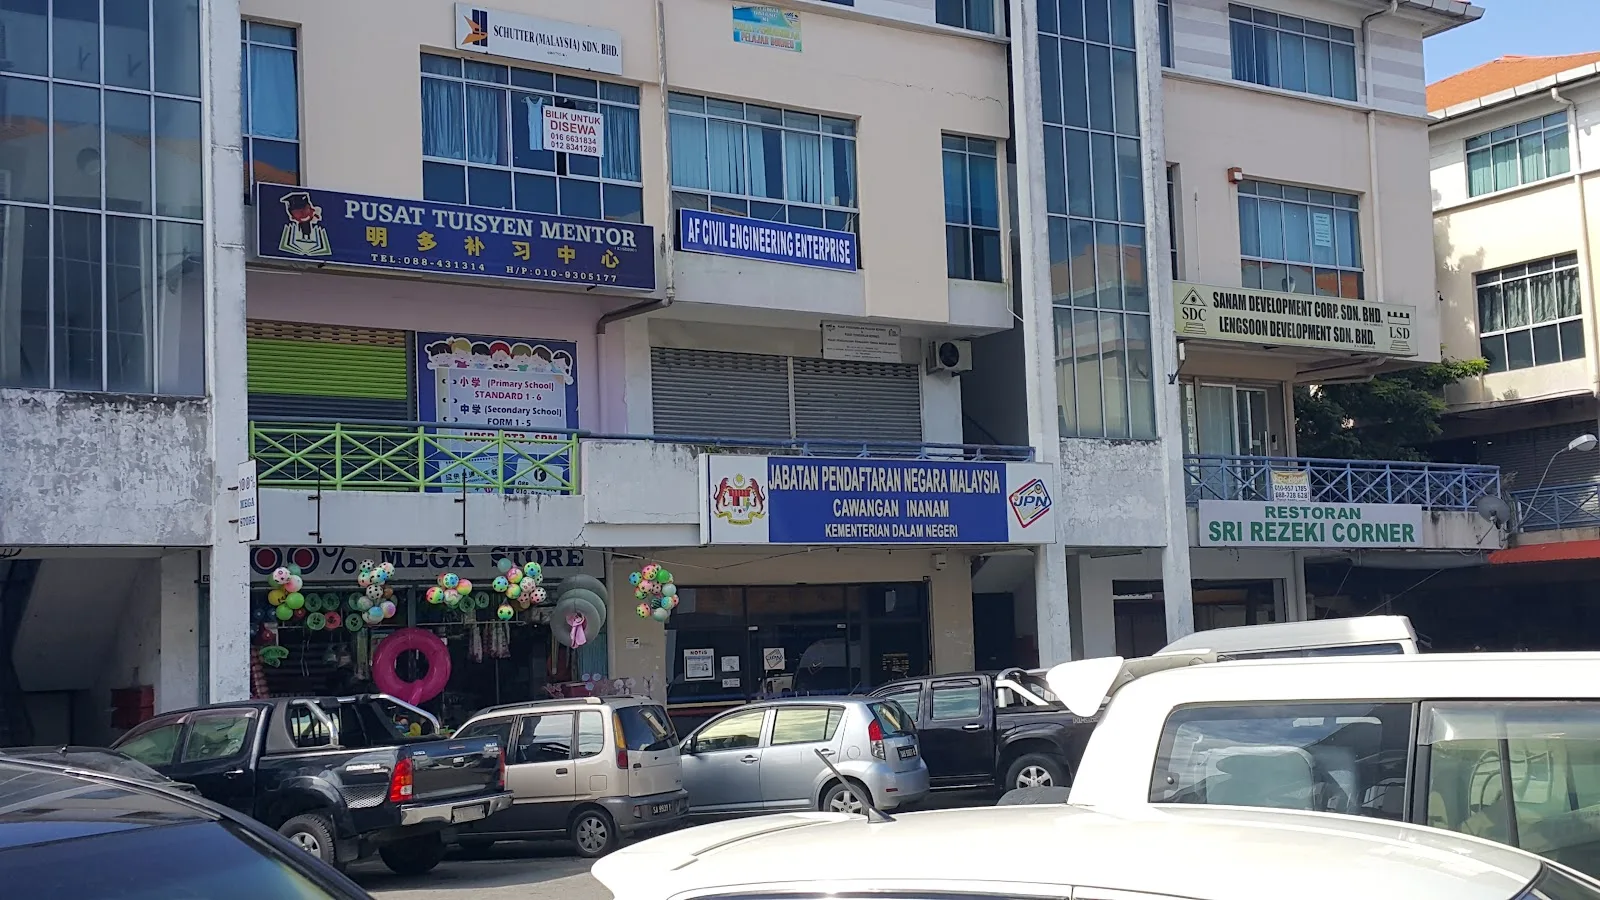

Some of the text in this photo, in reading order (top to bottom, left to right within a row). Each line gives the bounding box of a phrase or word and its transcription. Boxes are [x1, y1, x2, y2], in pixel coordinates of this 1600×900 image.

[493, 24, 619, 57] SCHUTTER (MALAYSIA) SDN. BHD.
[545, 109, 600, 125] BILIK UNTUK
[550, 120, 596, 136] DISEWA
[551, 132, 596, 145] 016 6631834
[551, 140, 597, 153] 012 8341289
[344, 200, 637, 247] PUSAT TUISYEN MENTOR
[365, 225, 620, 269] 明多补习中心
[688, 217, 851, 264] AF CIVIL ENGINEERING ENTERPRISE
[370, 254, 617, 283] TEL:088-431314 H/P:010-9305177
[1182, 307, 1207, 321] SDC
[1213, 291, 1384, 323] SANAM DEVELOPMENT CORP. SDN. BHD.
[1219, 316, 1376, 345] LENGSOON DEVELOPMENT SDN. BHD.
[1389, 327, 1410, 339] LSD
[460, 376, 481, 388] 小学
[487, 379, 554, 392] (Primary School)
[474, 391, 523, 400] STANDARD
[525, 392, 530, 401] 1
[536, 393, 542, 401] 6
[460, 404, 481, 415] 中学
[484, 404, 562, 418] (Secondary School)
[487, 417, 513, 426] FORM
[515, 418, 519, 427] 1
[526, 419, 531, 427] 5
[769, 464, 1000, 494] JABATAN PENDAFTARAN NEGARA MALAYSIA
[833, 498, 949, 518] CAWANGAN INANAM
[1013, 495, 1048, 507] JPN
[1265, 506, 1361, 519] RESTORAN
[825, 524, 958, 538] KEMENTERIAN DALAM NEGERI
[1208, 521, 1415, 543] SRI REZEKI CORNER
[250, 546, 584, 575] 00% MEGA STORE
